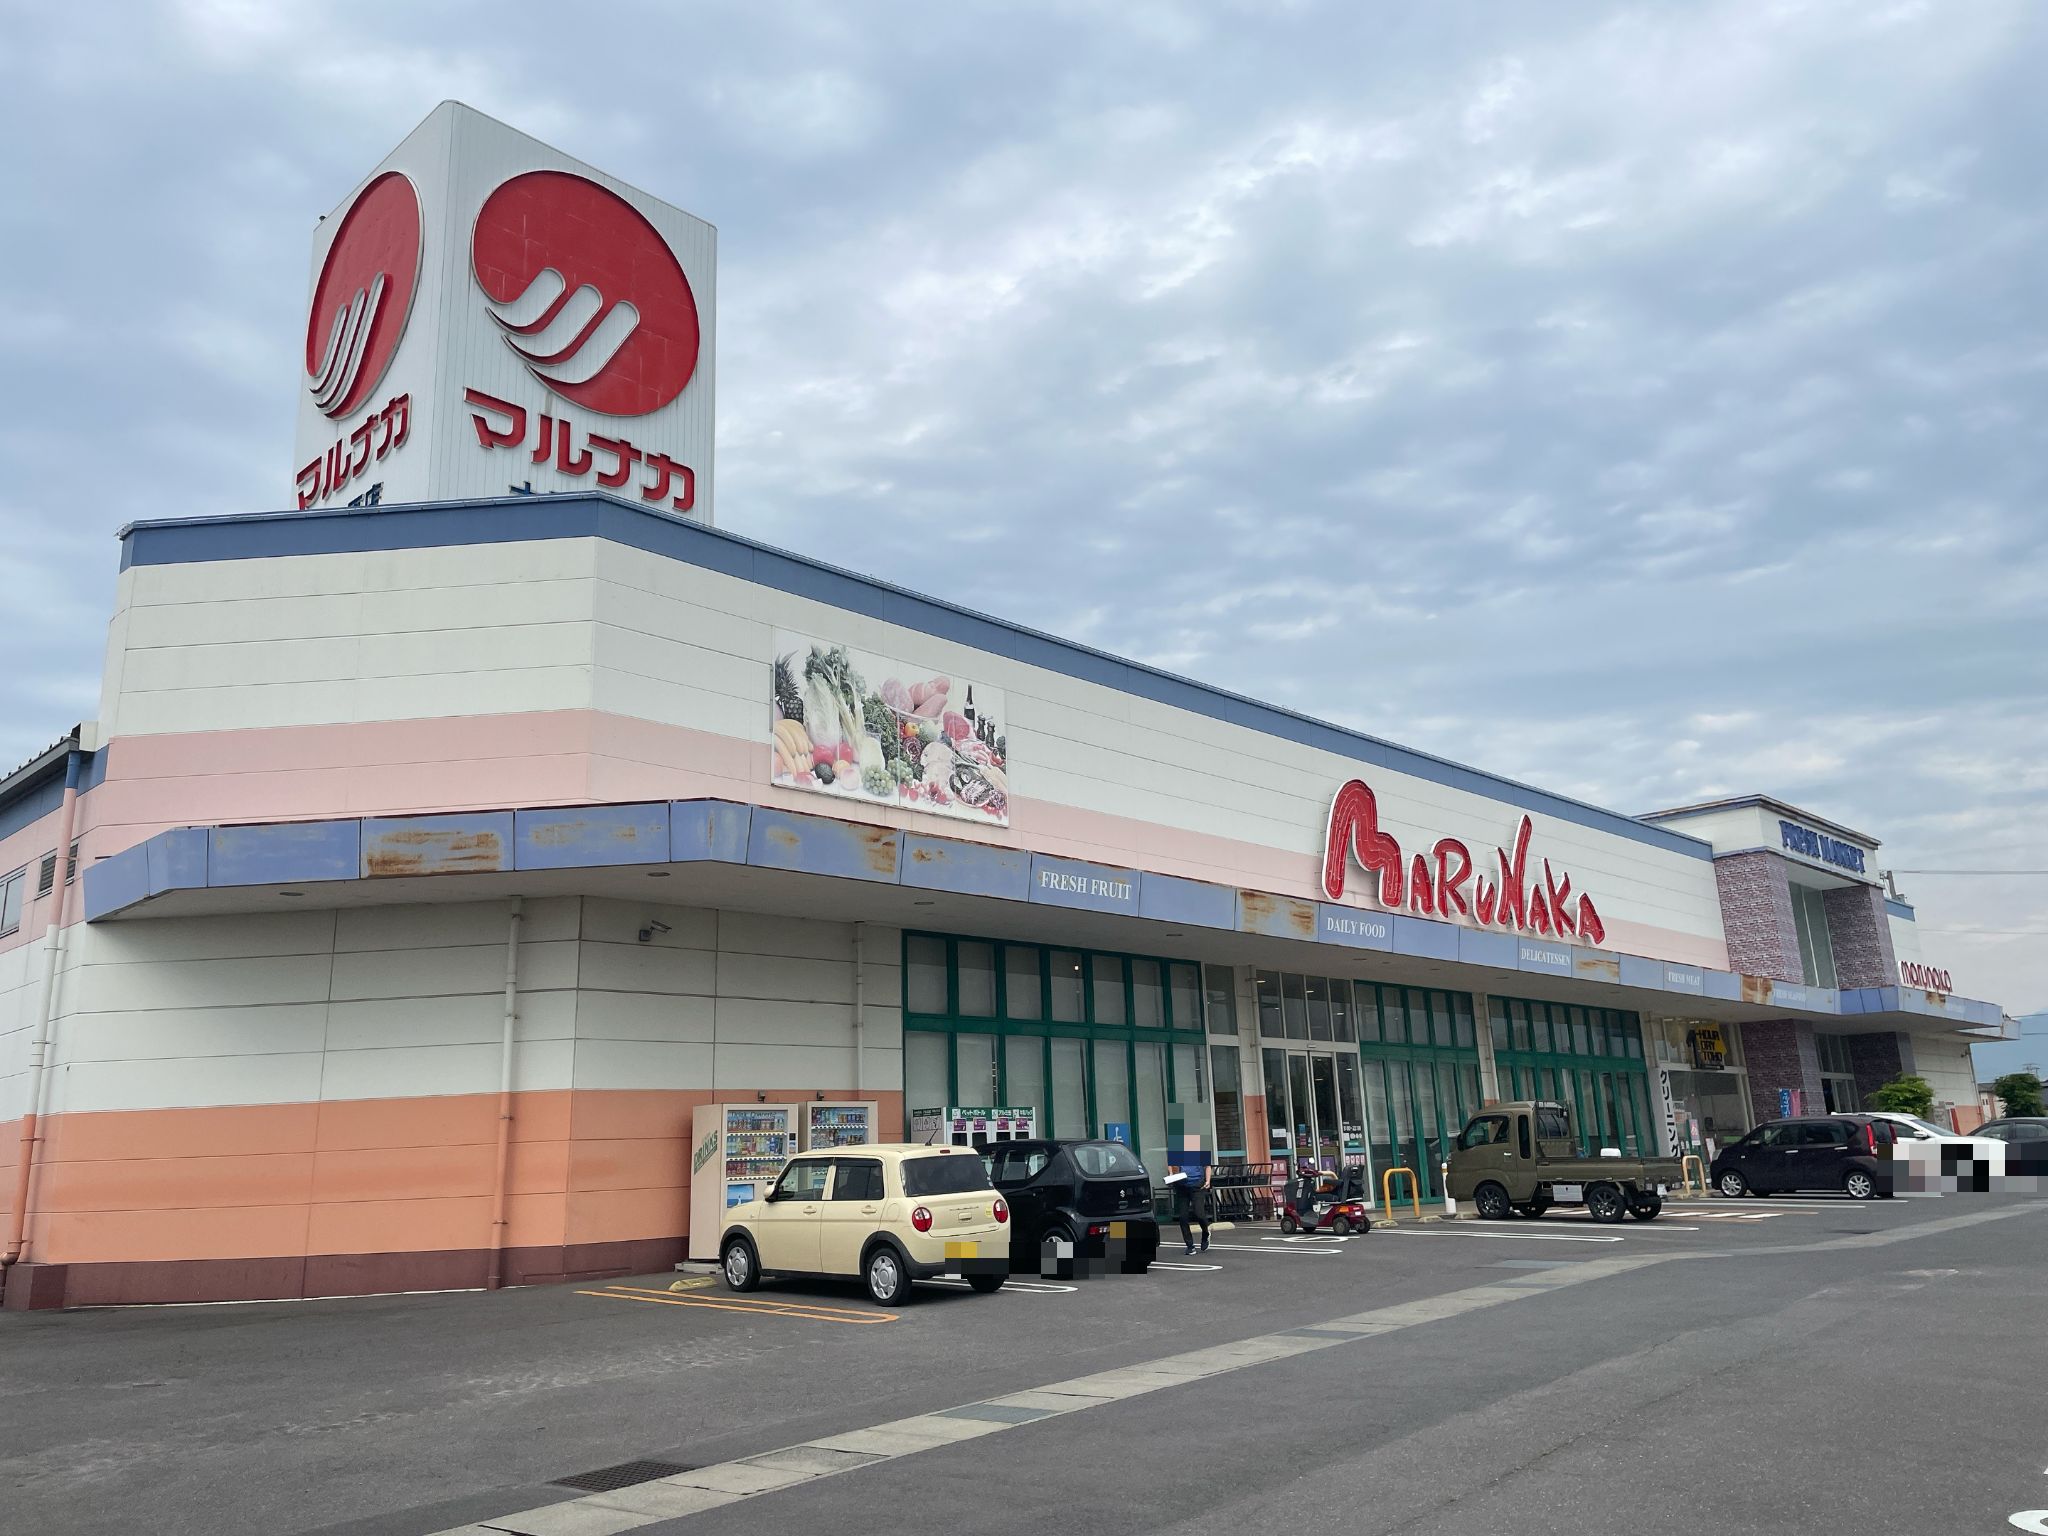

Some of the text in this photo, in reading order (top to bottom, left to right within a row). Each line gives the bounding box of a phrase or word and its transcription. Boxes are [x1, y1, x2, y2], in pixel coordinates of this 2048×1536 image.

[296, 392, 412, 510] マルナカ
[464, 386, 695, 513] マルナカ
[1818, 834, 1866, 874] MARKET
[1041, 871, 1132, 900] FRESH FRUIT
[1327, 917, 1386, 939] DAILY FOOD
[1520, 948, 1570, 966] DELICATESSEN
[1668, 971, 1701, 986] FRESH MEAT
[1660, 1070, 1680, 1158] クリーニング
[694, 1130, 718, 1167] DRINKS
